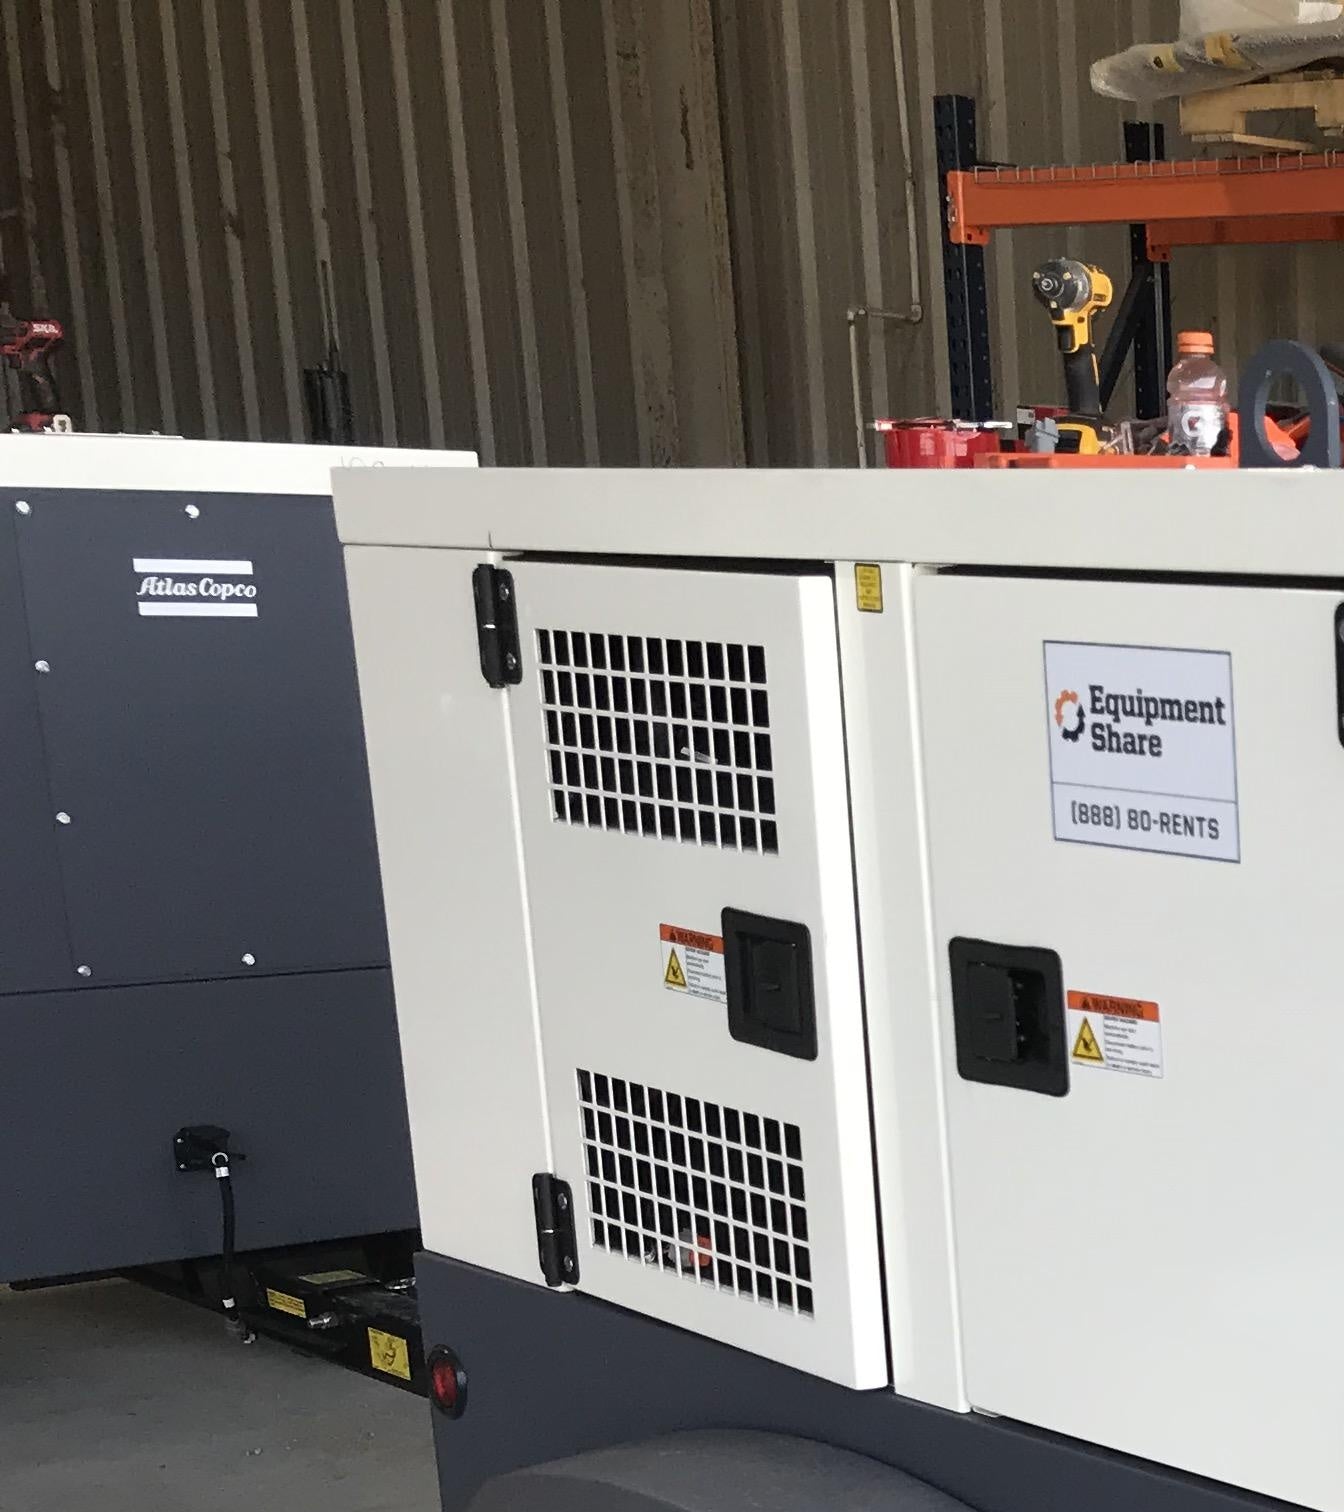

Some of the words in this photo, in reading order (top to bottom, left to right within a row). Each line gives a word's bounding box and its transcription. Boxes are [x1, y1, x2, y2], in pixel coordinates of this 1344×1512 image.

[136, 576, 197, 596] Atlas
[199, 577, 257, 600] Copco
[1089, 684, 1226, 726] Equipment
[1091, 722, 1162, 757] Share
[1071, 800, 1121, 830] (888)
